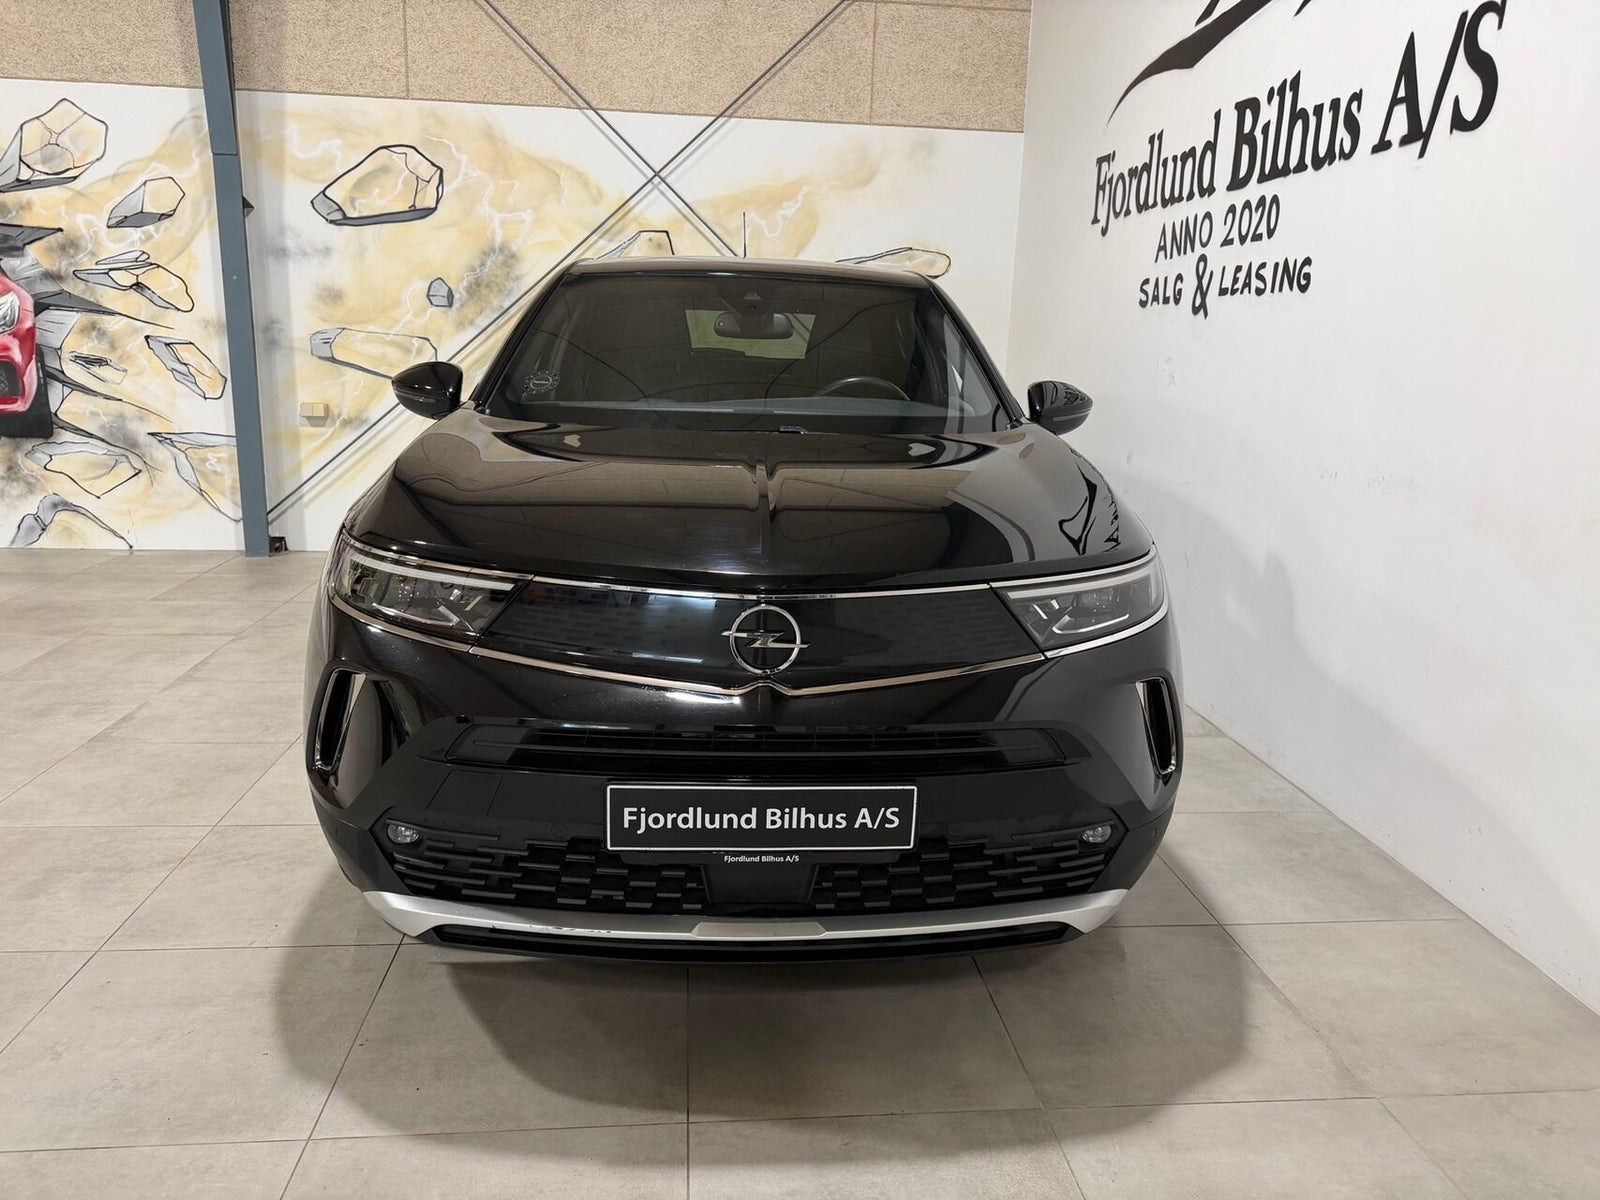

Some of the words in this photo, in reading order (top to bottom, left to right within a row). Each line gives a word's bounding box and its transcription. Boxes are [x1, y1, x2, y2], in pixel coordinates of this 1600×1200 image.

[1091, 108, 1222, 237] Fjordlund
[1225, 69, 1363, 192] Bilhus
[1370, 0, 1508, 160] A/S
[1154, 211, 1214, 263] ANNO
[1219, 194, 1281, 248] 2020
[1138, 273, 1184, 309] SALG
[1191, 253, 1214, 320] &
[1218, 256, 1313, 297] LEASING
[622, 806, 757, 835] Fjordlund
[765, 807, 847, 830] Bilhus
[854, 806, 901, 830] A/S
[723, 854, 760, 864] Fjordlund
[761, 855, 785, 863] Bilhus
[785, 854, 800, 863] A/S
